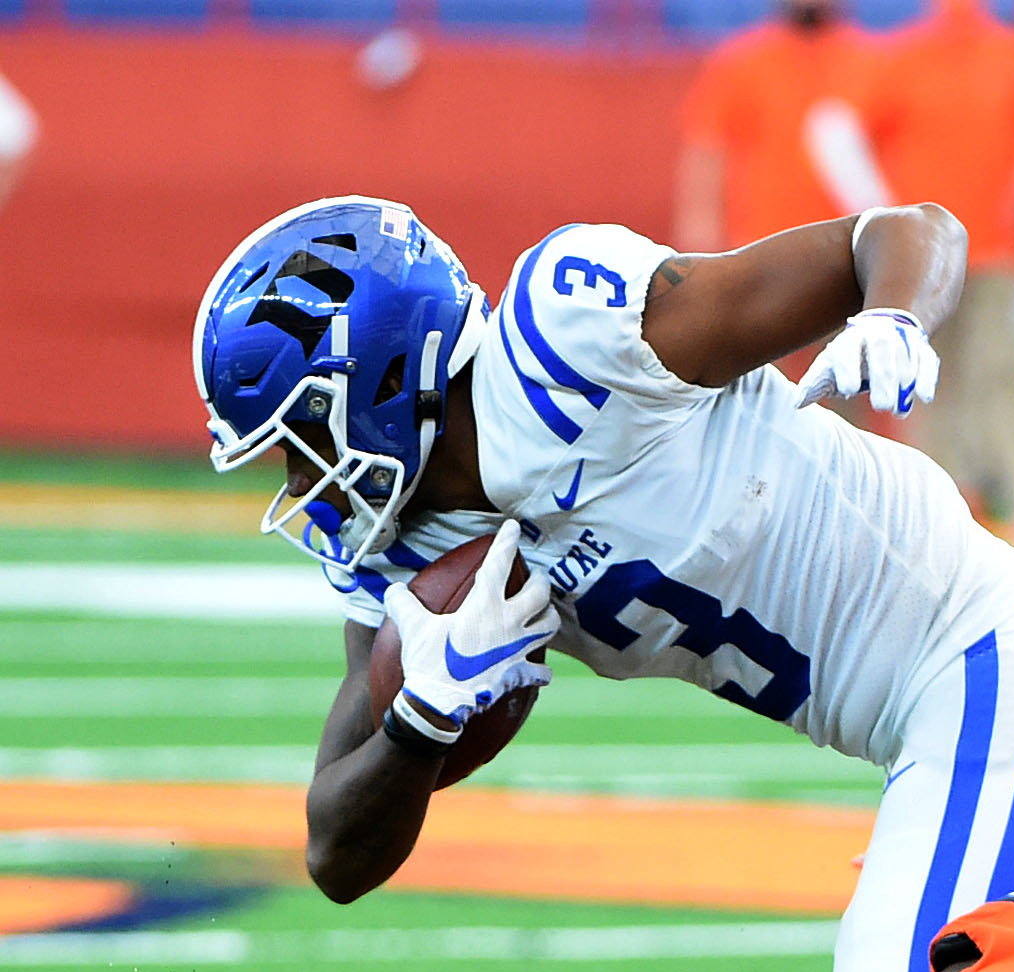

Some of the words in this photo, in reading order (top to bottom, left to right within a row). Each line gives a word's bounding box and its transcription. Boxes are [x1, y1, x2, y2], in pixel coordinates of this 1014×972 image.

[552, 255, 628, 308] 3
[549, 528, 613, 599] UKE
[574, 558, 812, 722] 3
